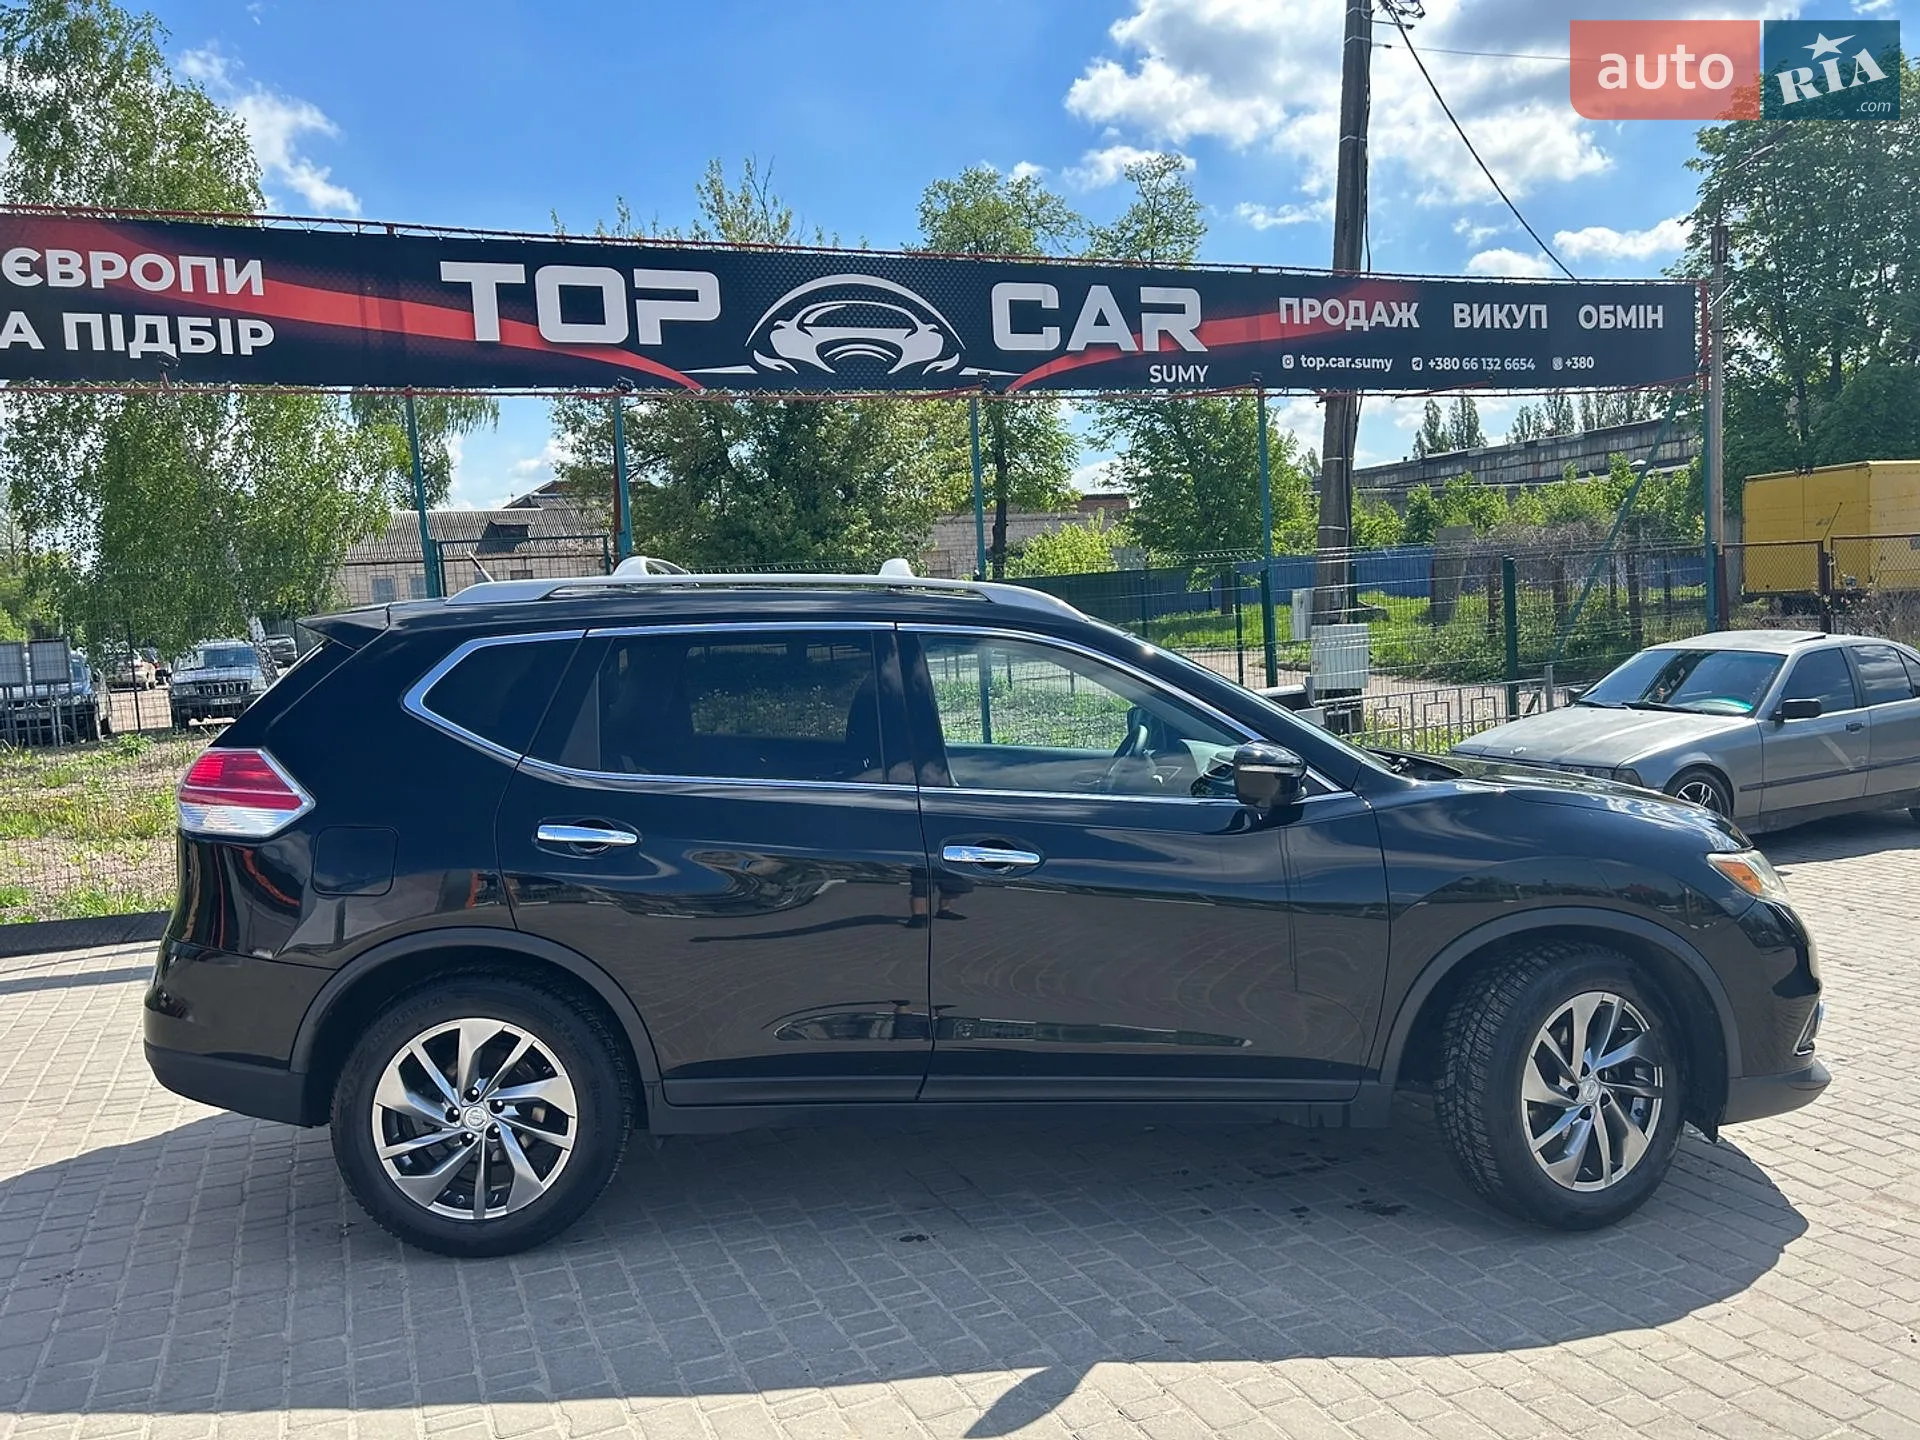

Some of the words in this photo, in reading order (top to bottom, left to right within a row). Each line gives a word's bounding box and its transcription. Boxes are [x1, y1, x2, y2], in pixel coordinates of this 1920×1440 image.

[1, 247, 264, 297] ЄВРОПИ
[439, 260, 722, 345] TOP
[991, 282, 1209, 352] CAR
[1278, 297, 1421, 332] ПРОДАЖ
[1453, 302, 1548, 330] ВИКУП
[1578, 304, 1664, 330] ОБМІН
[62, 311, 275, 359] ПІДБІР
[1149, 364, 1209, 384] SUMY
[1299, 354, 1393, 373] top.car.sumy
[1428, 357, 1460, 371] +380
[1462, 357, 1479, 371] 66
[1481, 357, 1501, 371] 132
[1503, 357, 1536, 371] 6654
[1565, 356, 1595, 370] +380
